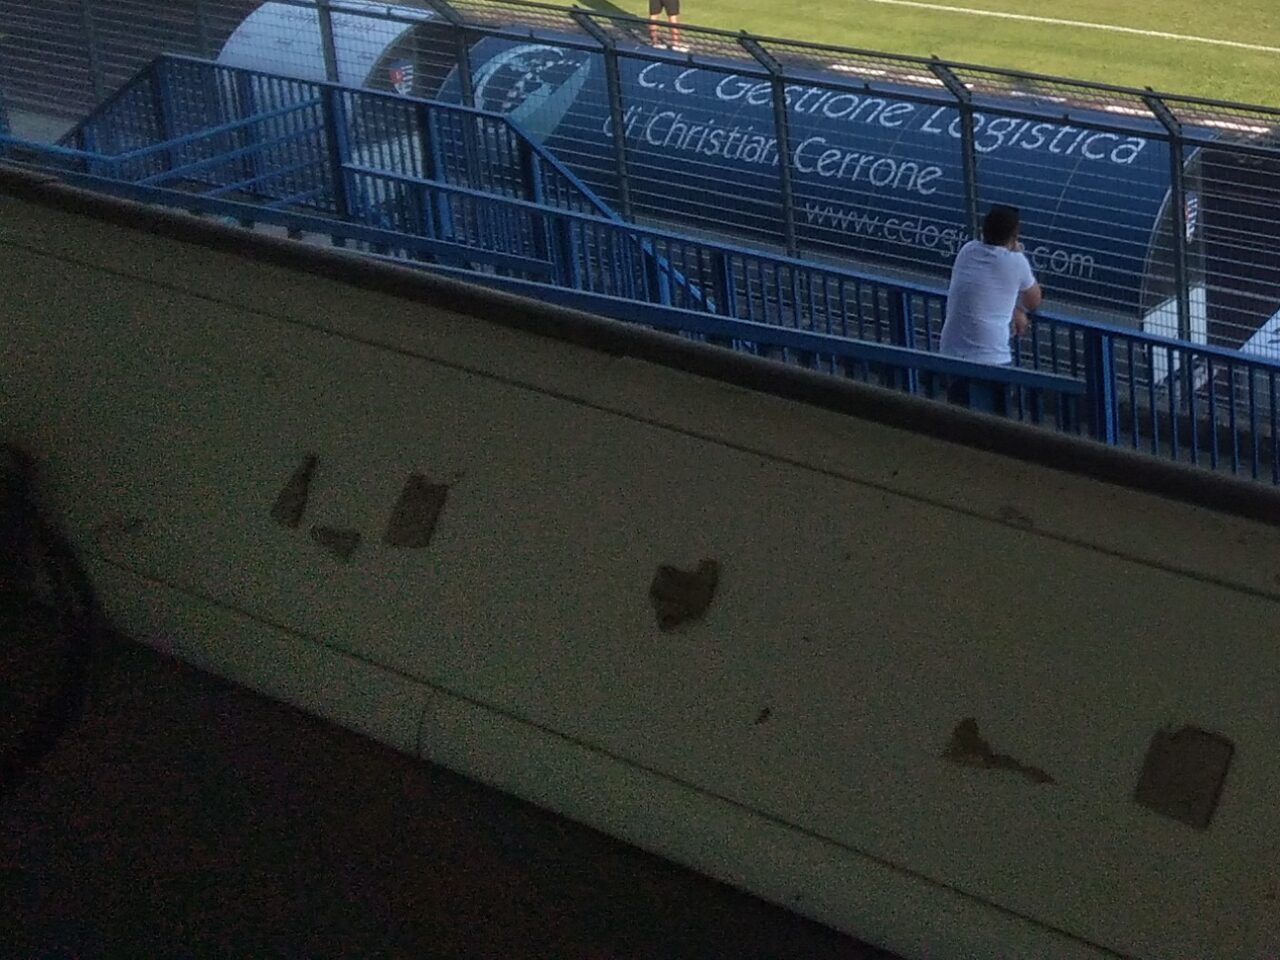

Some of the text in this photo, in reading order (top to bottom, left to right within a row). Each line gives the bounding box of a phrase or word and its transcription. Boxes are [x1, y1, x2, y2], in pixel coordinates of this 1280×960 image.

[645, 111, 781, 167] Christian
[793, 135, 945, 195] Cerrone
[715, 73, 916, 128] Gestione
[919, 105, 1148, 165] Logistica
